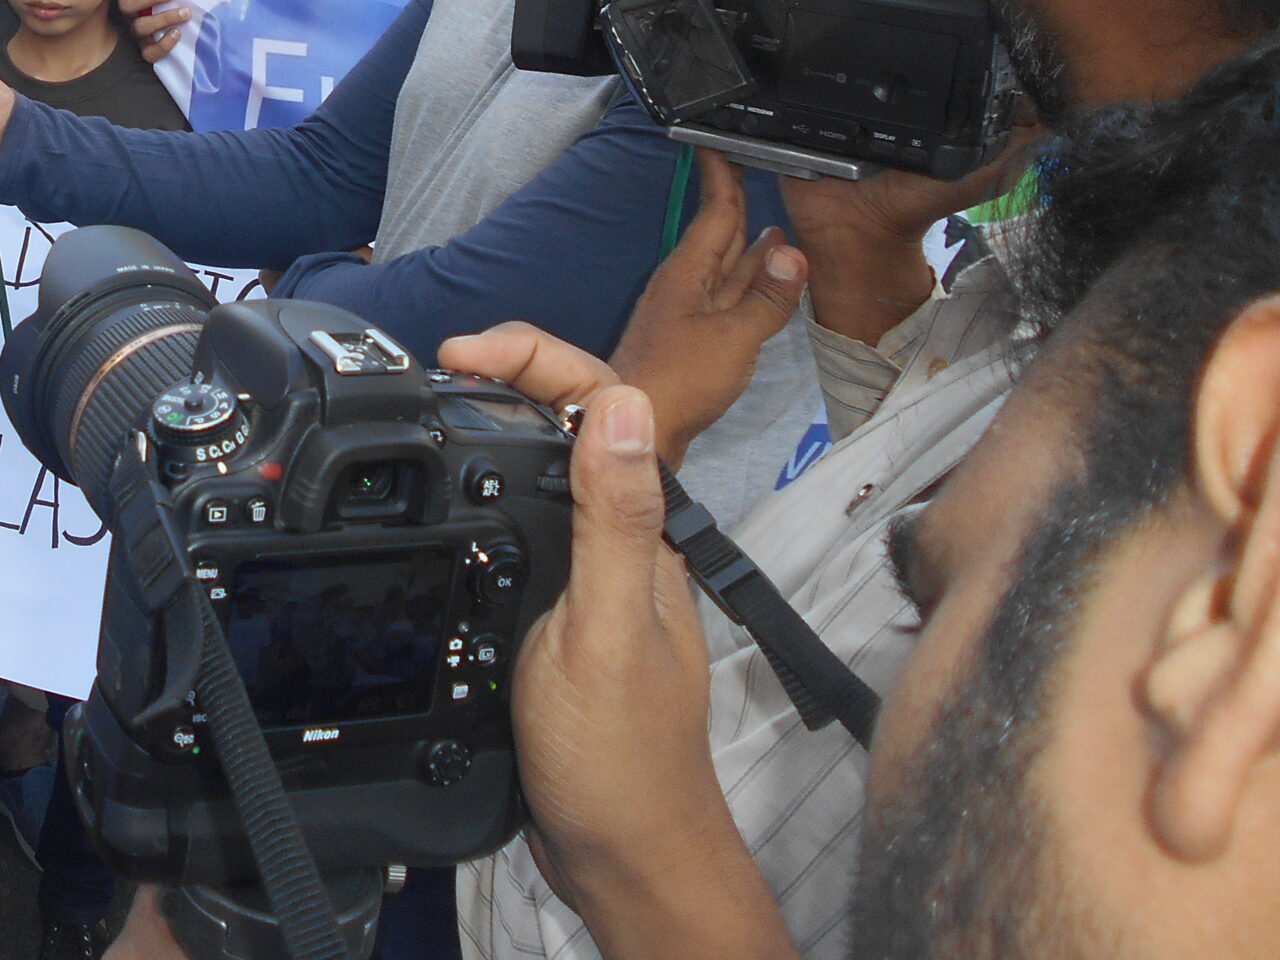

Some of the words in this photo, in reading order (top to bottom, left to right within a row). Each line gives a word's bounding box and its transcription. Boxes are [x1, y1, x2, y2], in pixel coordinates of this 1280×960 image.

[196, 568, 218, 578] MENU
[497, 577, 512, 588] OK
[302, 728, 340, 743] Nikon
